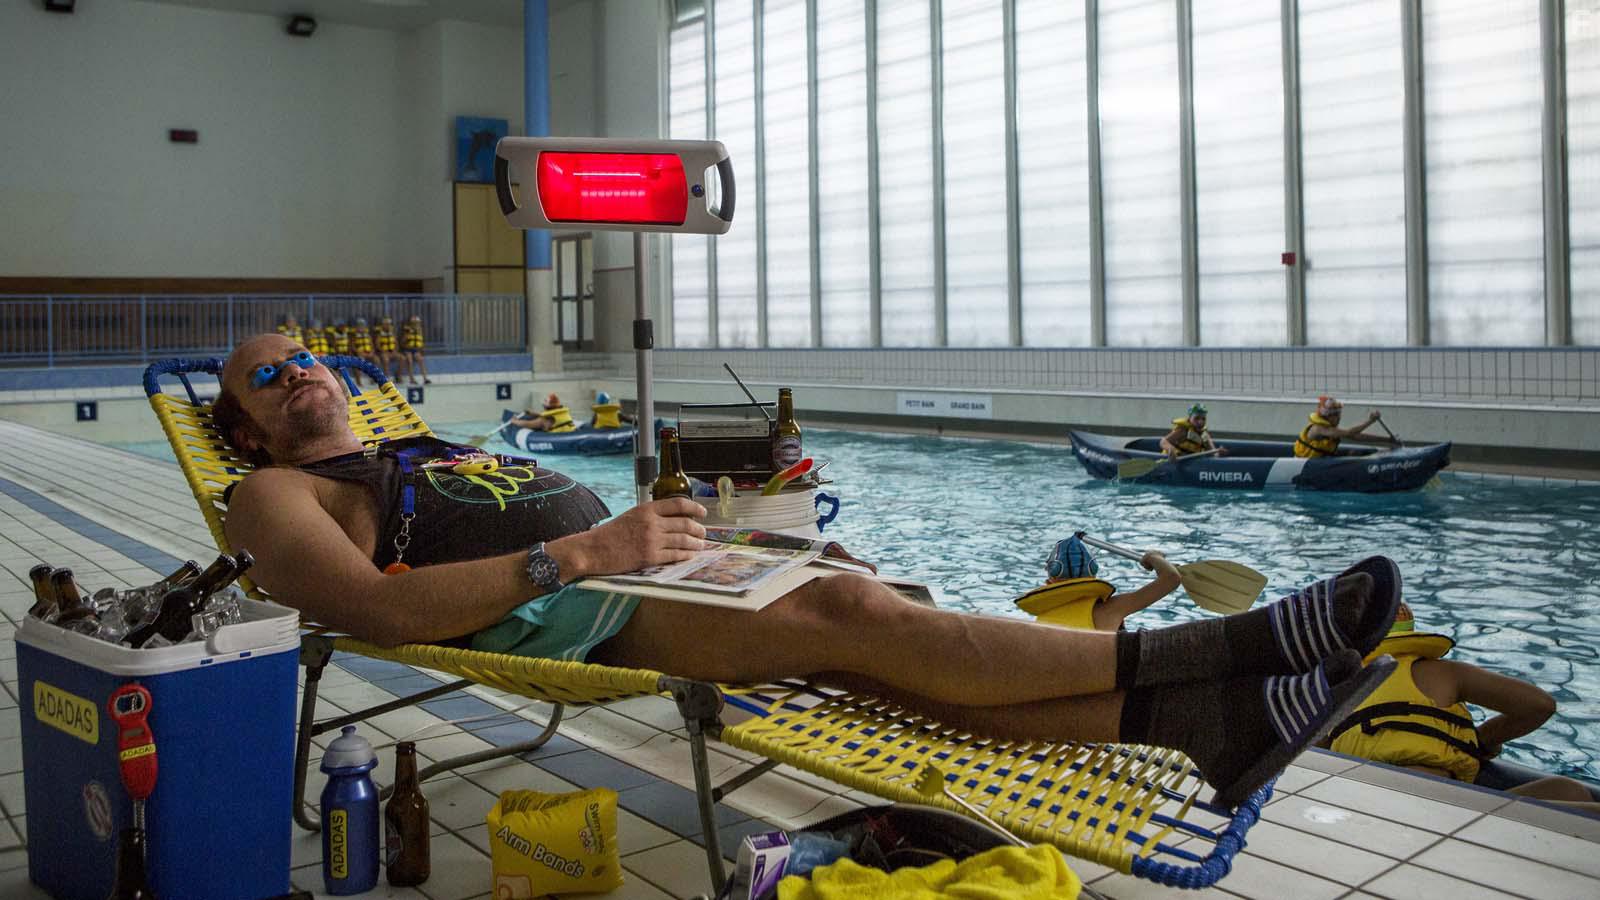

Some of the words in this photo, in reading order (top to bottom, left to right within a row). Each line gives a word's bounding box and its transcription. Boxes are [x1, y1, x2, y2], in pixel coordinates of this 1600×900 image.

[1199, 471, 1253, 482] RIVIERA
[38, 688, 93, 734] ADADAS
[122, 746, 155, 758] ADADAS
[333, 815, 344, 873] ADADAS
[496, 826, 532, 857] Arm
[532, 843, 585, 878] Bands
